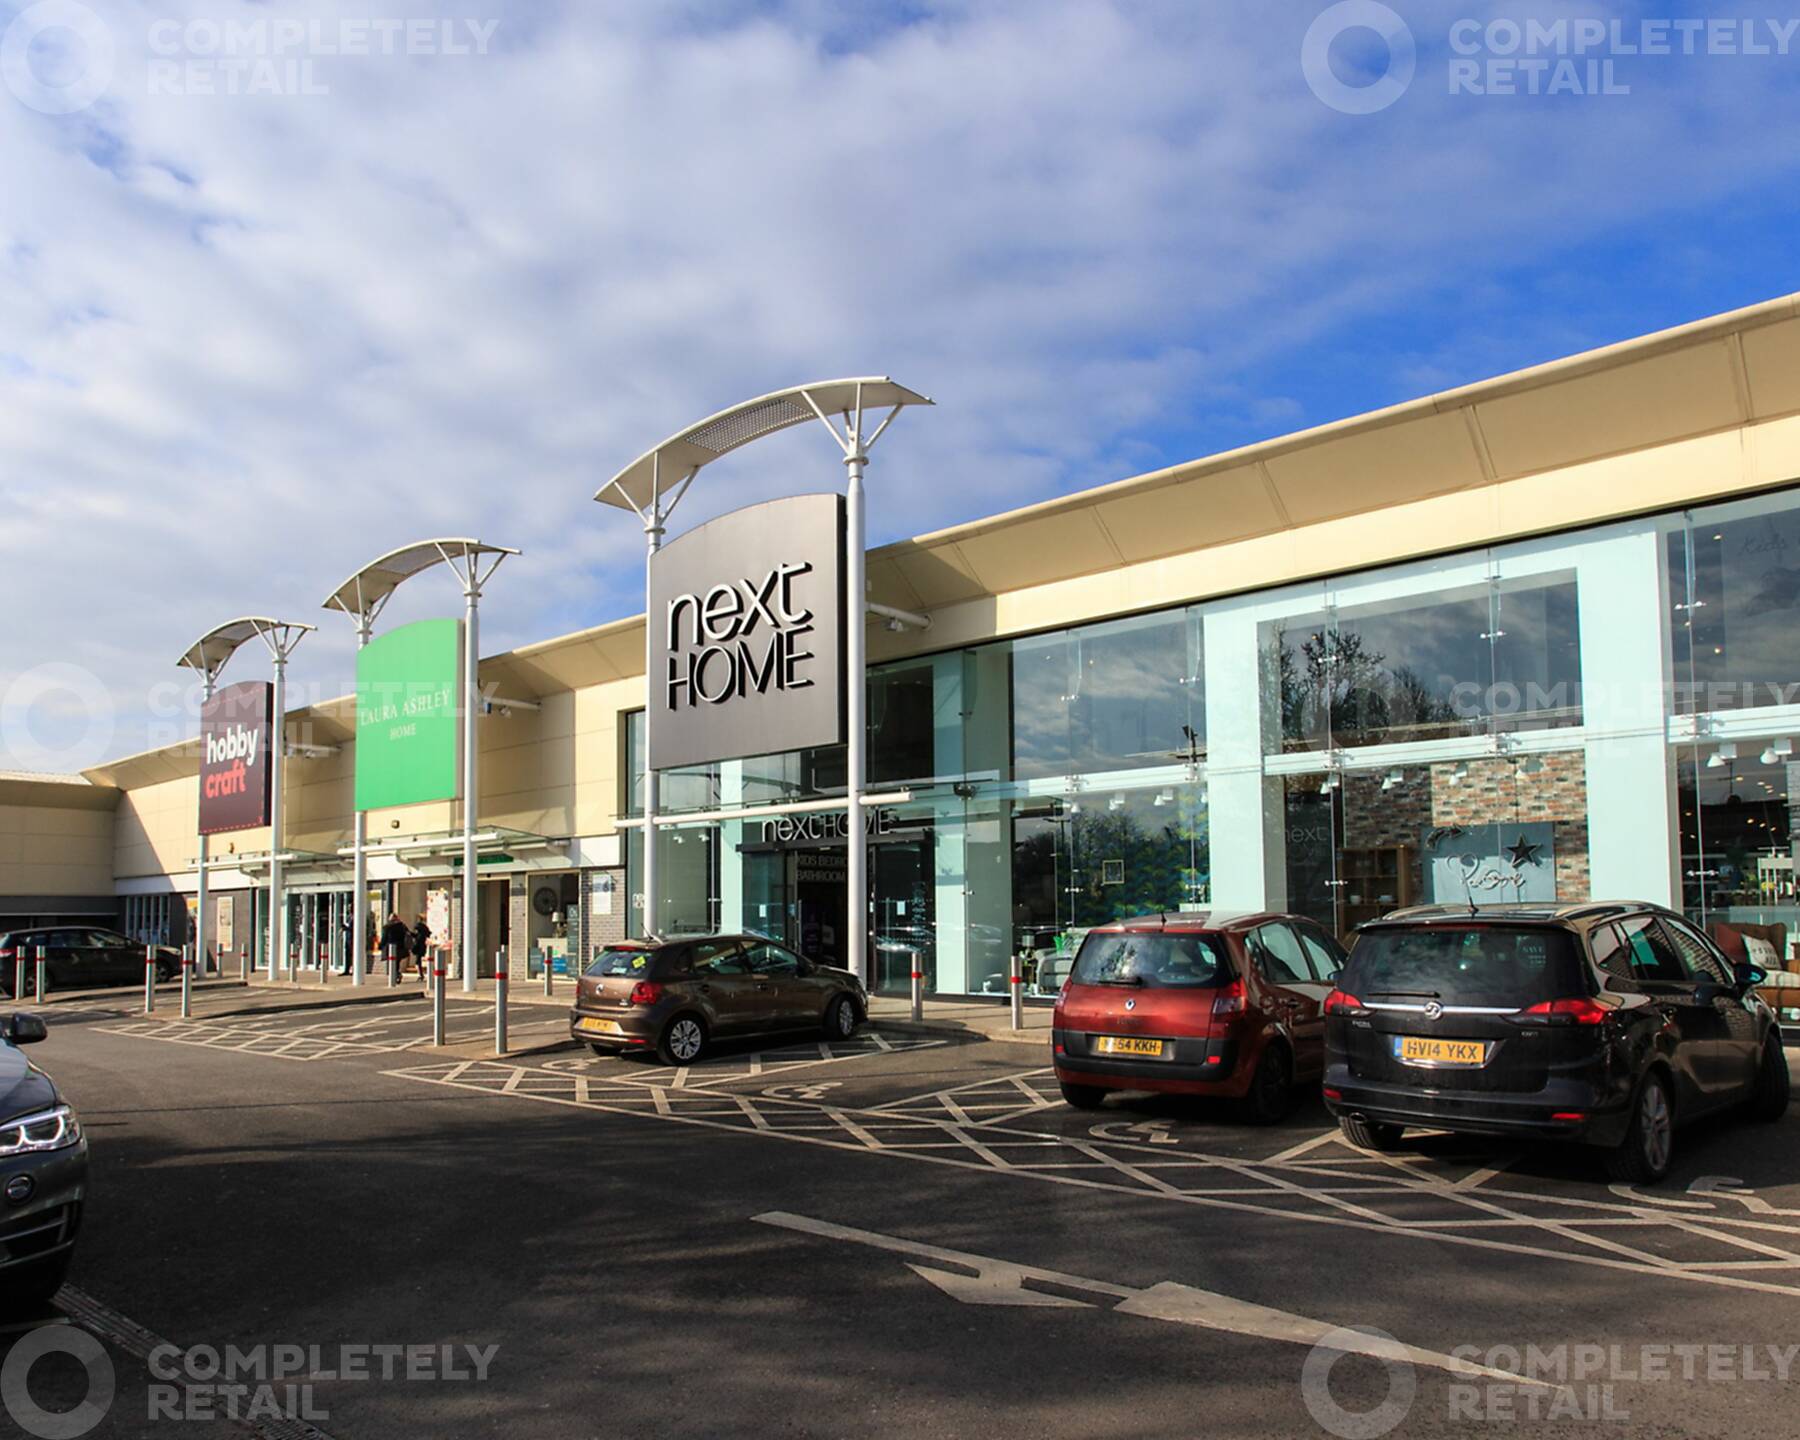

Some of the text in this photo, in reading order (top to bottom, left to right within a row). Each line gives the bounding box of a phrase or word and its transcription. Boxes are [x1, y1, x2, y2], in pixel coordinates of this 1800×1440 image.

[667, 560, 814, 653] next
[666, 623, 815, 712] HOME
[360, 687, 450, 727] LAURA ASHLEY
[206, 723, 259, 767] hobby
[389, 722, 417, 741] HOME
[205, 758, 247, 799] craft
[1134, 1039, 1157, 1053] KKH
[1406, 1041, 1478, 1060] HV14 YKX
